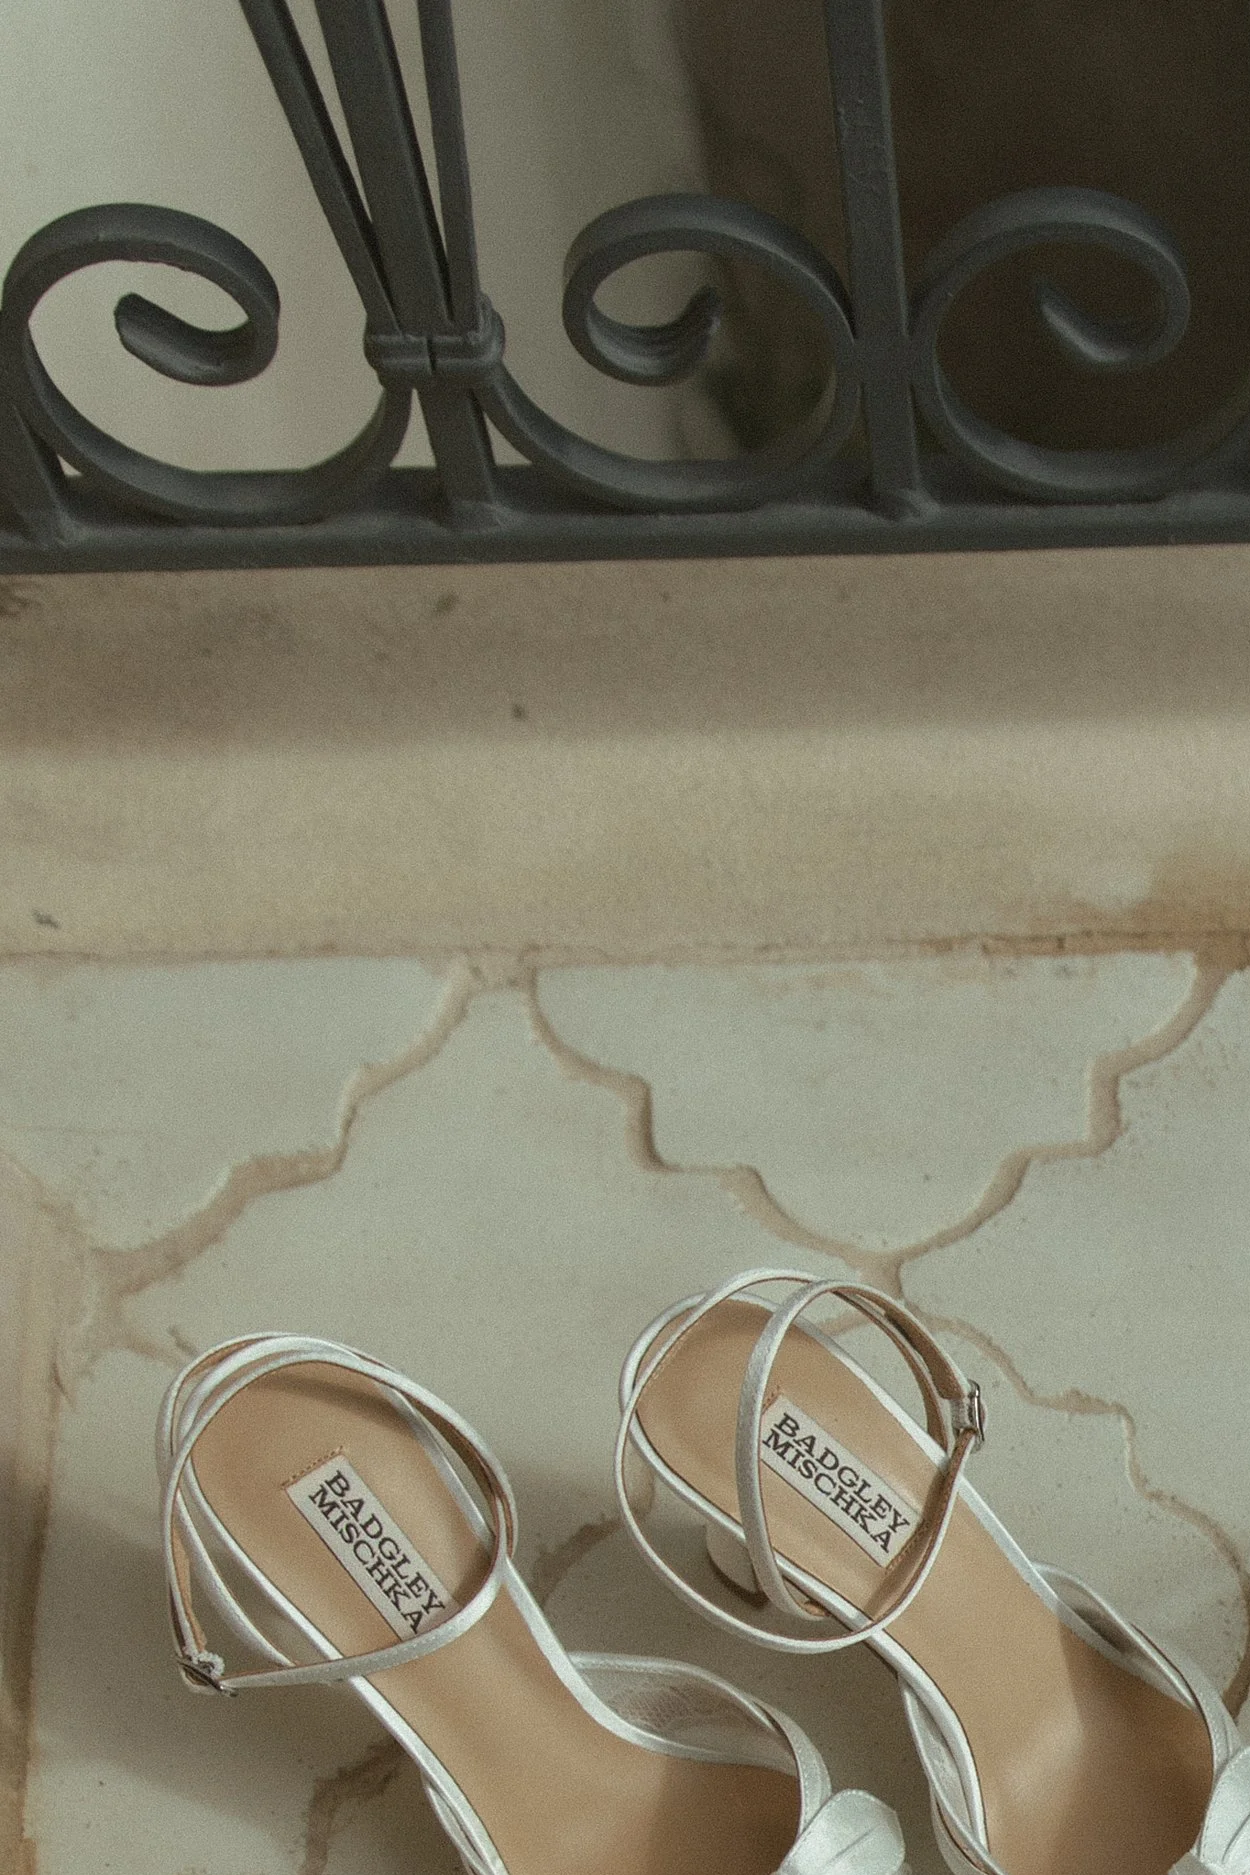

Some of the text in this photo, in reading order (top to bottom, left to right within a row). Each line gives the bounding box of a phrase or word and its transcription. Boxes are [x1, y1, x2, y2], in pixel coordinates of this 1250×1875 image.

[762, 1428, 889, 1553] MISCHKA
[773, 1412, 910, 1533] BADGLEY
[308, 1484, 424, 1634] MISCHKA
[325, 1470, 446, 1615] BADGLEY
